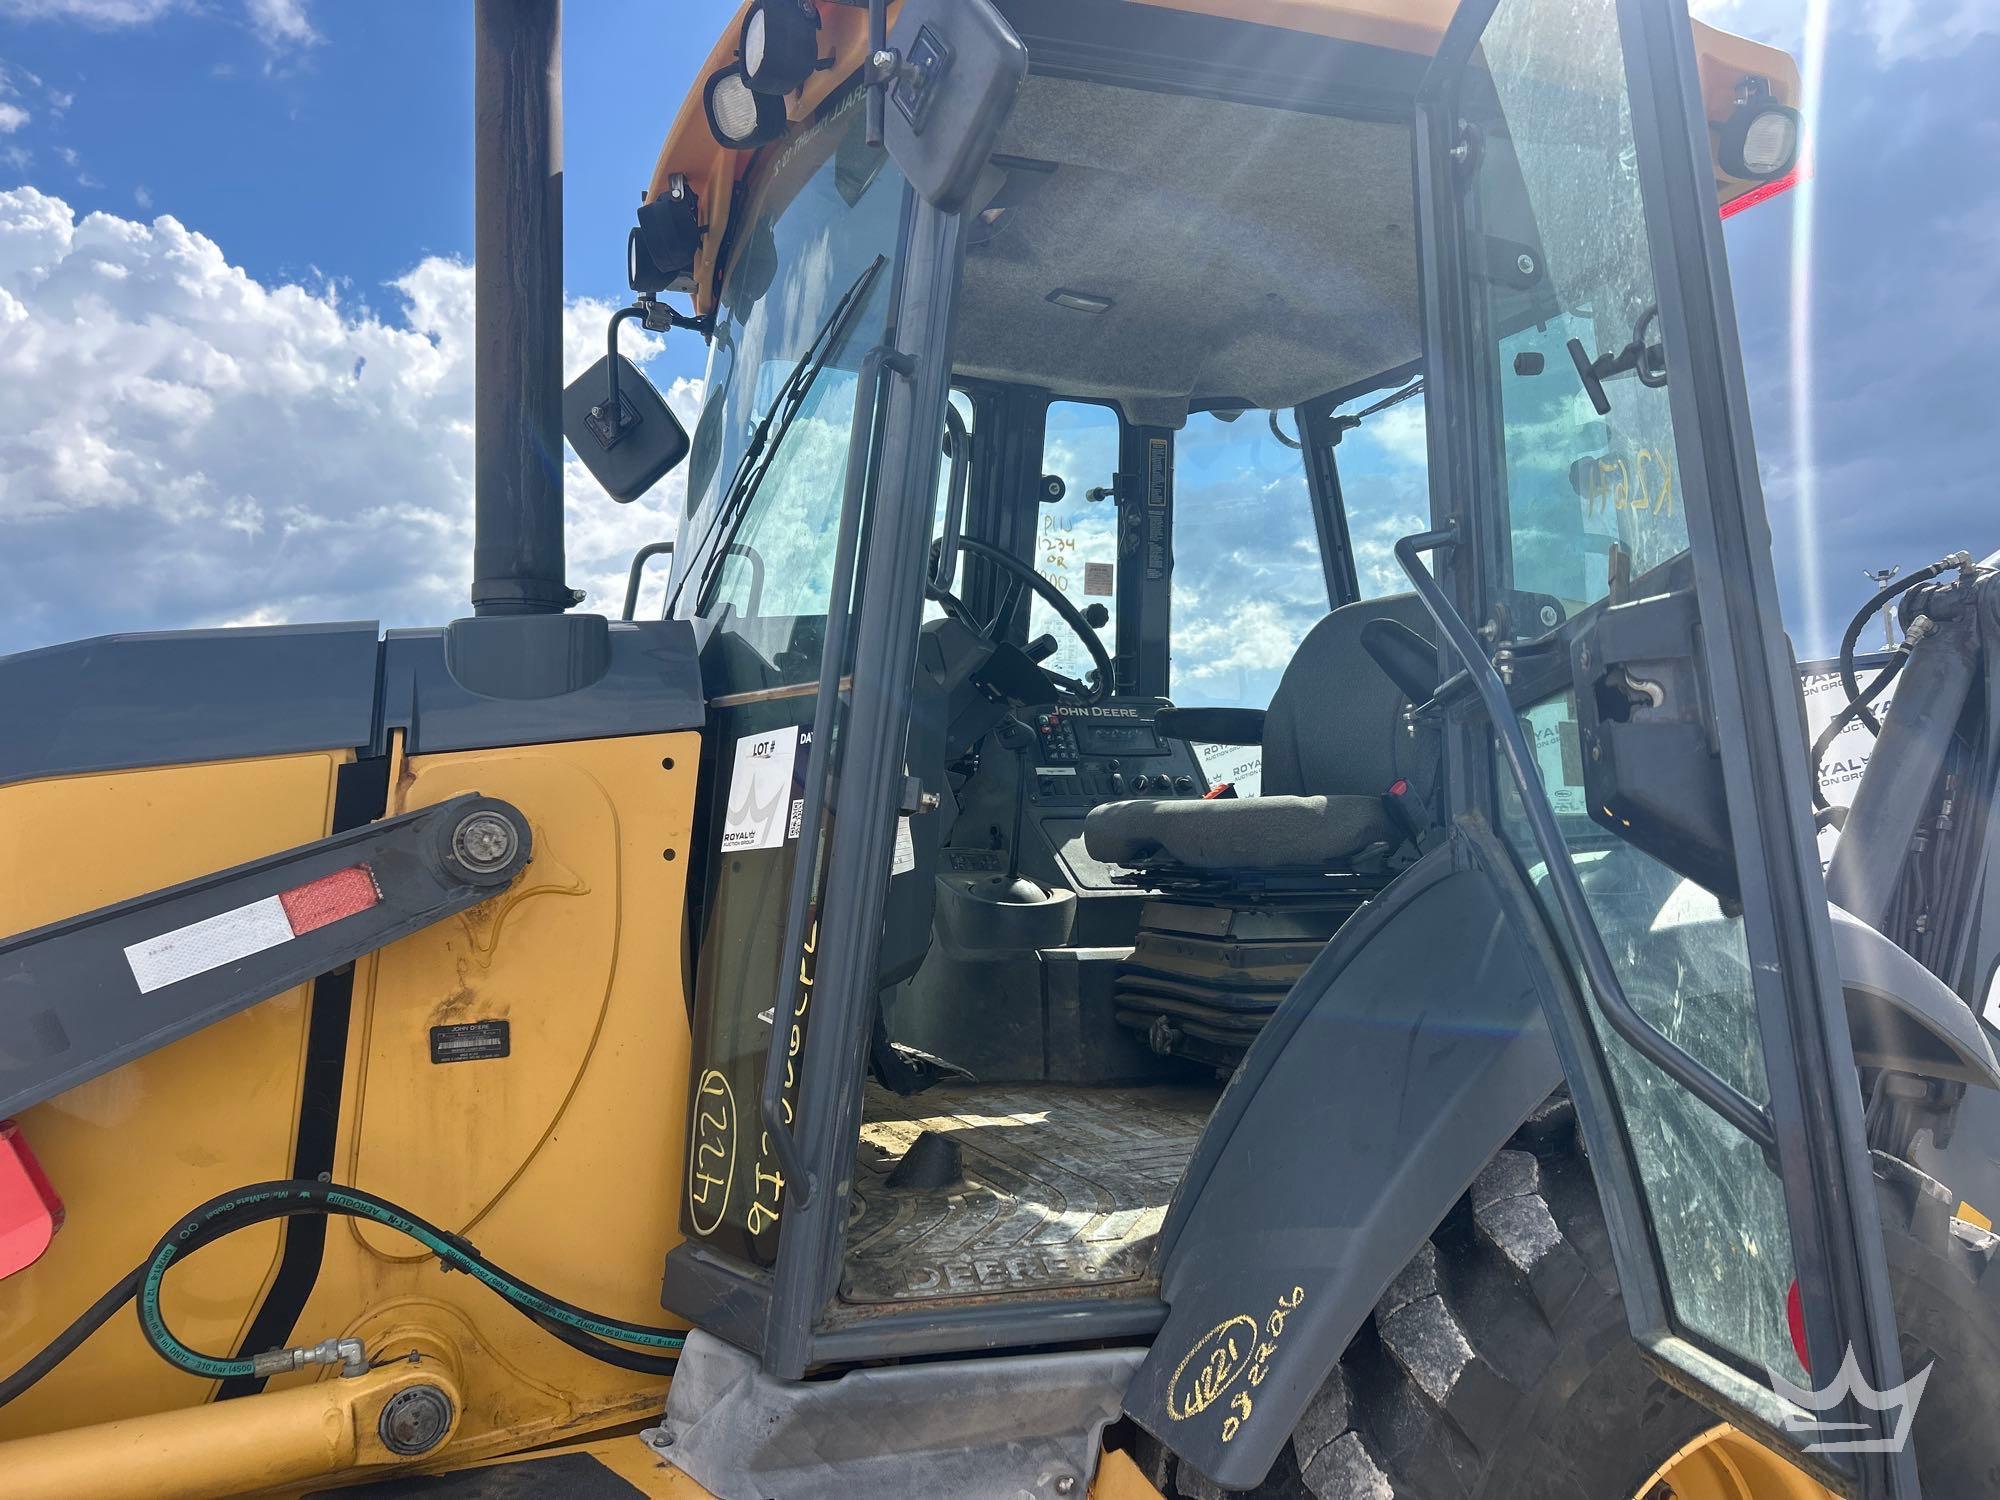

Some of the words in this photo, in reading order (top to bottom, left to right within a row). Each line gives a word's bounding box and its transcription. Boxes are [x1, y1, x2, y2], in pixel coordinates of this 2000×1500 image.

[1037, 536, 1076, 553] 1234
[1051, 705, 1089, 717] JOHN
[1092, 706, 1138, 718] DEERE
[800, 731, 814, 745] DA
[753, 742, 770, 756] LOT
[724, 832, 749, 842] ROYAL
[329, 1194, 380, 1215] AEROQUIP
[903, 1255, 1075, 1291] DEERE
